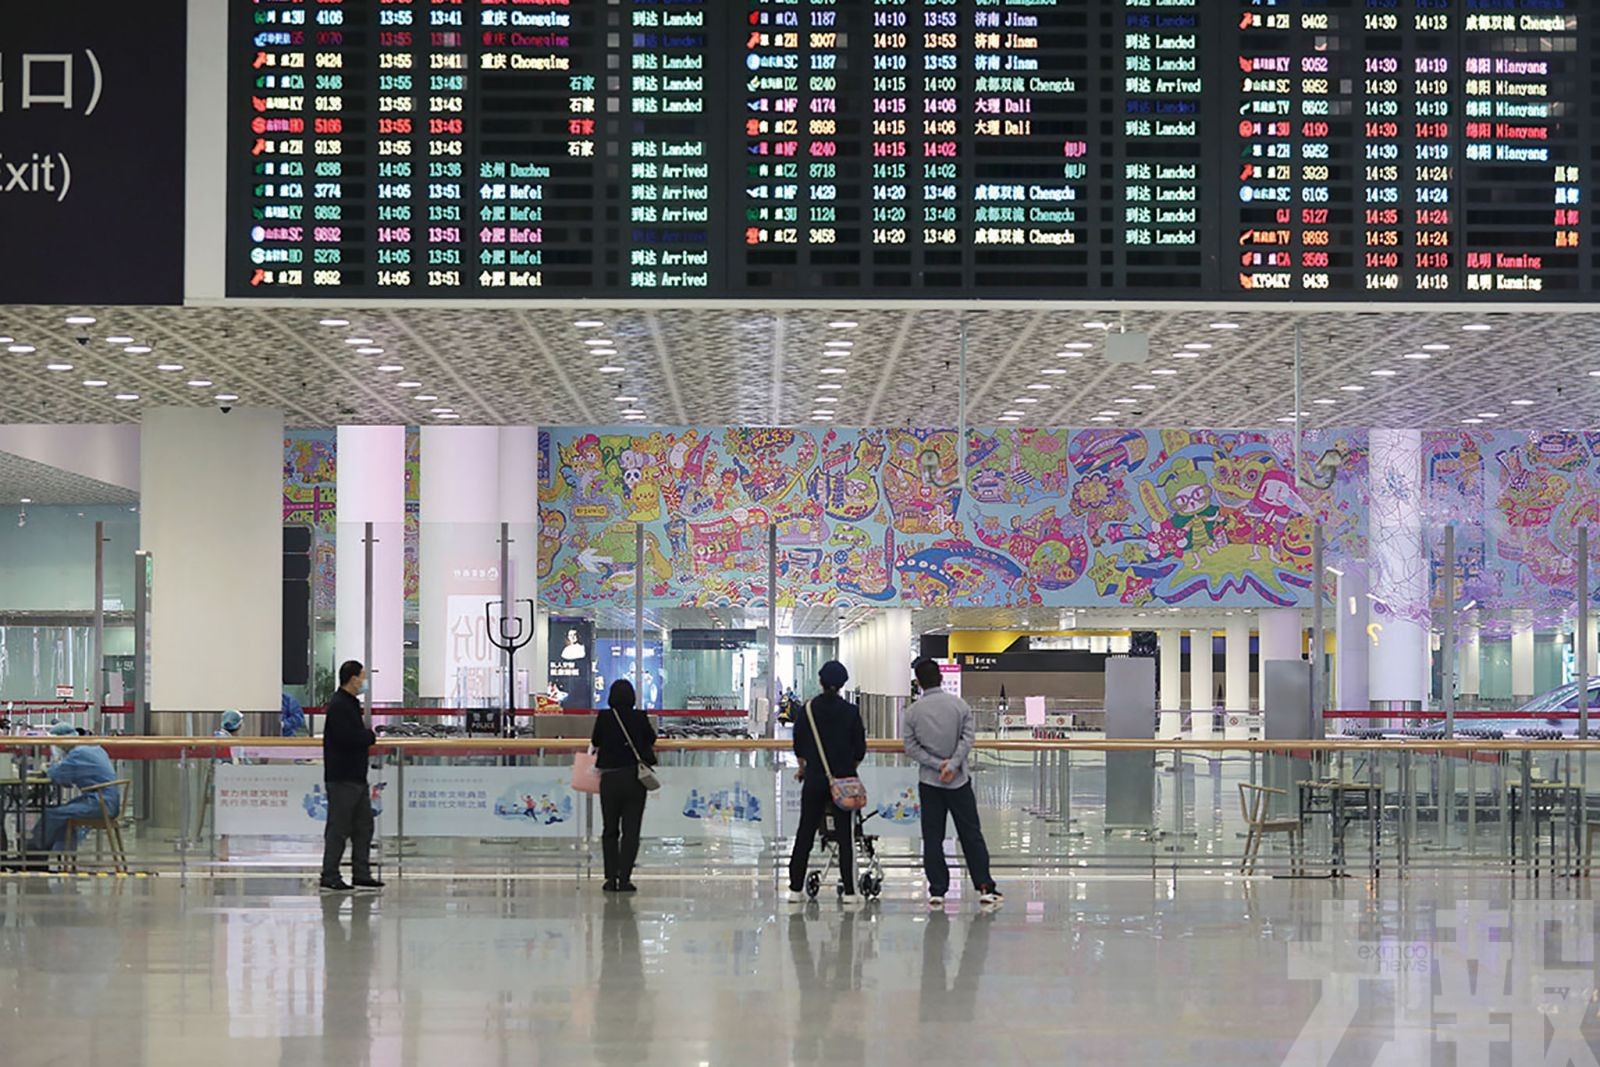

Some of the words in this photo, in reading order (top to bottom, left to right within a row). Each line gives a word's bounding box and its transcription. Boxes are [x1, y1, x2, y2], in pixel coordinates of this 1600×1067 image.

[381, 11, 412, 25] 13:55
[431, 11, 462, 25] 13:41
[511, 11, 569, 26] Chongqing
[664, 12, 703, 25] Landed
[811, 12, 835, 25] 1187
[875, 12, 906, 26] 14:10
[925, 12, 956, 26] 13:53
[1005, 13, 1037, 26] Jinan
[1302, 14, 1327, 28] 9402
[1365, 15, 1397, 29] 14:30
[1415, 15, 1447, 29] 14:13
[810, 33, 836, 47] 3007
[874, 34, 906, 48] 14:10
[924, 34, 956, 48] 13:53
[1005, 34, 1037, 48] Jinan
[1156, 35, 1195, 49] Landed
[316, 53, 342, 67] 9424
[380, 54, 412, 68] 13:55
[431, 54, 462, 68] 13:41
[511, 54, 569, 70] Chongqing
[663, 55, 702, 68] Landed
[811, 55, 836, 69] 1187
[874, 55, 906, 69] 14:10
[925, 55, 956, 69] 13:53
[1005, 55, 1037, 69] Jinan
[1157, 57, 1195, 70] Landed
[1302, 58, 1327, 71] 9052
[1366, 58, 1397, 72] 14:30
[1415, 58, 1447, 72] 14:19
[0, 49, 103, 115] 口)
[380, 76, 412, 89] 13:55
[431, 76, 463, 90] 13:43
[663, 77, 702, 90] Landed
[874, 77, 905, 91] 14:15
[925, 77, 956, 91] 14:00
[1156, 78, 1201, 92] Arrived
[1366, 80, 1397, 93] 14:30
[1416, 80, 1447, 94] 14:19
[380, 97, 411, 111] 13:55
[430, 97, 462, 111] 13:43
[663, 98, 702, 112] Landed
[810, 98, 835, 112] 4174
[874, 98, 905, 112] 14:15
[1005, 99, 1030, 112] Dali
[1366, 101, 1397, 115] 14:30
[1416, 101, 1447, 115] 14:19
[380, 119, 411, 133] 13:55
[430, 119, 462, 133] 13:43
[874, 120, 905, 134] 14:15
[1005, 120, 1030, 135] Dali
[1156, 121, 1195, 135] Landed
[1366, 123, 1397, 136] 14:30
[1416, 124, 1447, 137] 14:19
[379, 141, 411, 155] 13:55
[430, 141, 462, 155] 13:43
[662, 142, 701, 156] Landed
[810, 142, 835, 156] 4240
[874, 142, 905, 156] 14:15
[925, 142, 956, 156] 14:02
[1366, 144, 1397, 159] 14:30
[1416, 145, 1448, 159] 14:19
[380, 163, 411, 176] 14:05
[511, 163, 549, 177] Dazhou
[662, 164, 707, 177] Arrived
[810, 164, 835, 177] 8718
[874, 164, 905, 177] 14:15
[925, 164, 955, 178] 14:02
[1157, 165, 1195, 178] Landed
[1366, 166, 1397, 180] 14:35
[1416, 167, 1447, 180] 14:24
[314, 184, 341, 198] 3774
[379, 184, 411, 198] 14:05
[429, 184, 460, 198] 13:51
[510, 185, 541, 199] Hefei
[662, 185, 707, 199] Arrived
[810, 185, 836, 199] 1429
[873, 185, 905, 199] 14:20
[1157, 187, 1195, 200] Landed
[1366, 188, 1397, 202] 14:35
[1416, 188, 1448, 202] 14:24
[379, 206, 410, 220] 14:05
[430, 206, 460, 220] 13:51
[510, 207, 541, 220] Hefei
[662, 207, 707, 221] Arrived
[811, 207, 835, 221] 1124
[874, 207, 905, 221] 14:20
[1157, 208, 1195, 222] Landed
[1303, 209, 1328, 223] 5127
[1366, 210, 1397, 223] 14:35
[1417, 210, 1448, 224] 14:24
[378, 228, 410, 242] 14:05
[429, 228, 459, 242] 13:51
[874, 229, 905, 243] 14:20
[1157, 230, 1195, 244] Landed
[1367, 231, 1397, 245] 14:35
[1417, 232, 1447, 245] 14:24
[378, 250, 410, 263] 14:05
[429, 250, 460, 263] 13:51
[662, 251, 707, 264] Arrived
[1367, 253, 1397, 267] 14:40
[378, 271, 410, 285] 14:05
[429, 271, 459, 285] 13:51
[662, 272, 707, 286] Arrived
[1366, 274, 1398, 288] 14:40
